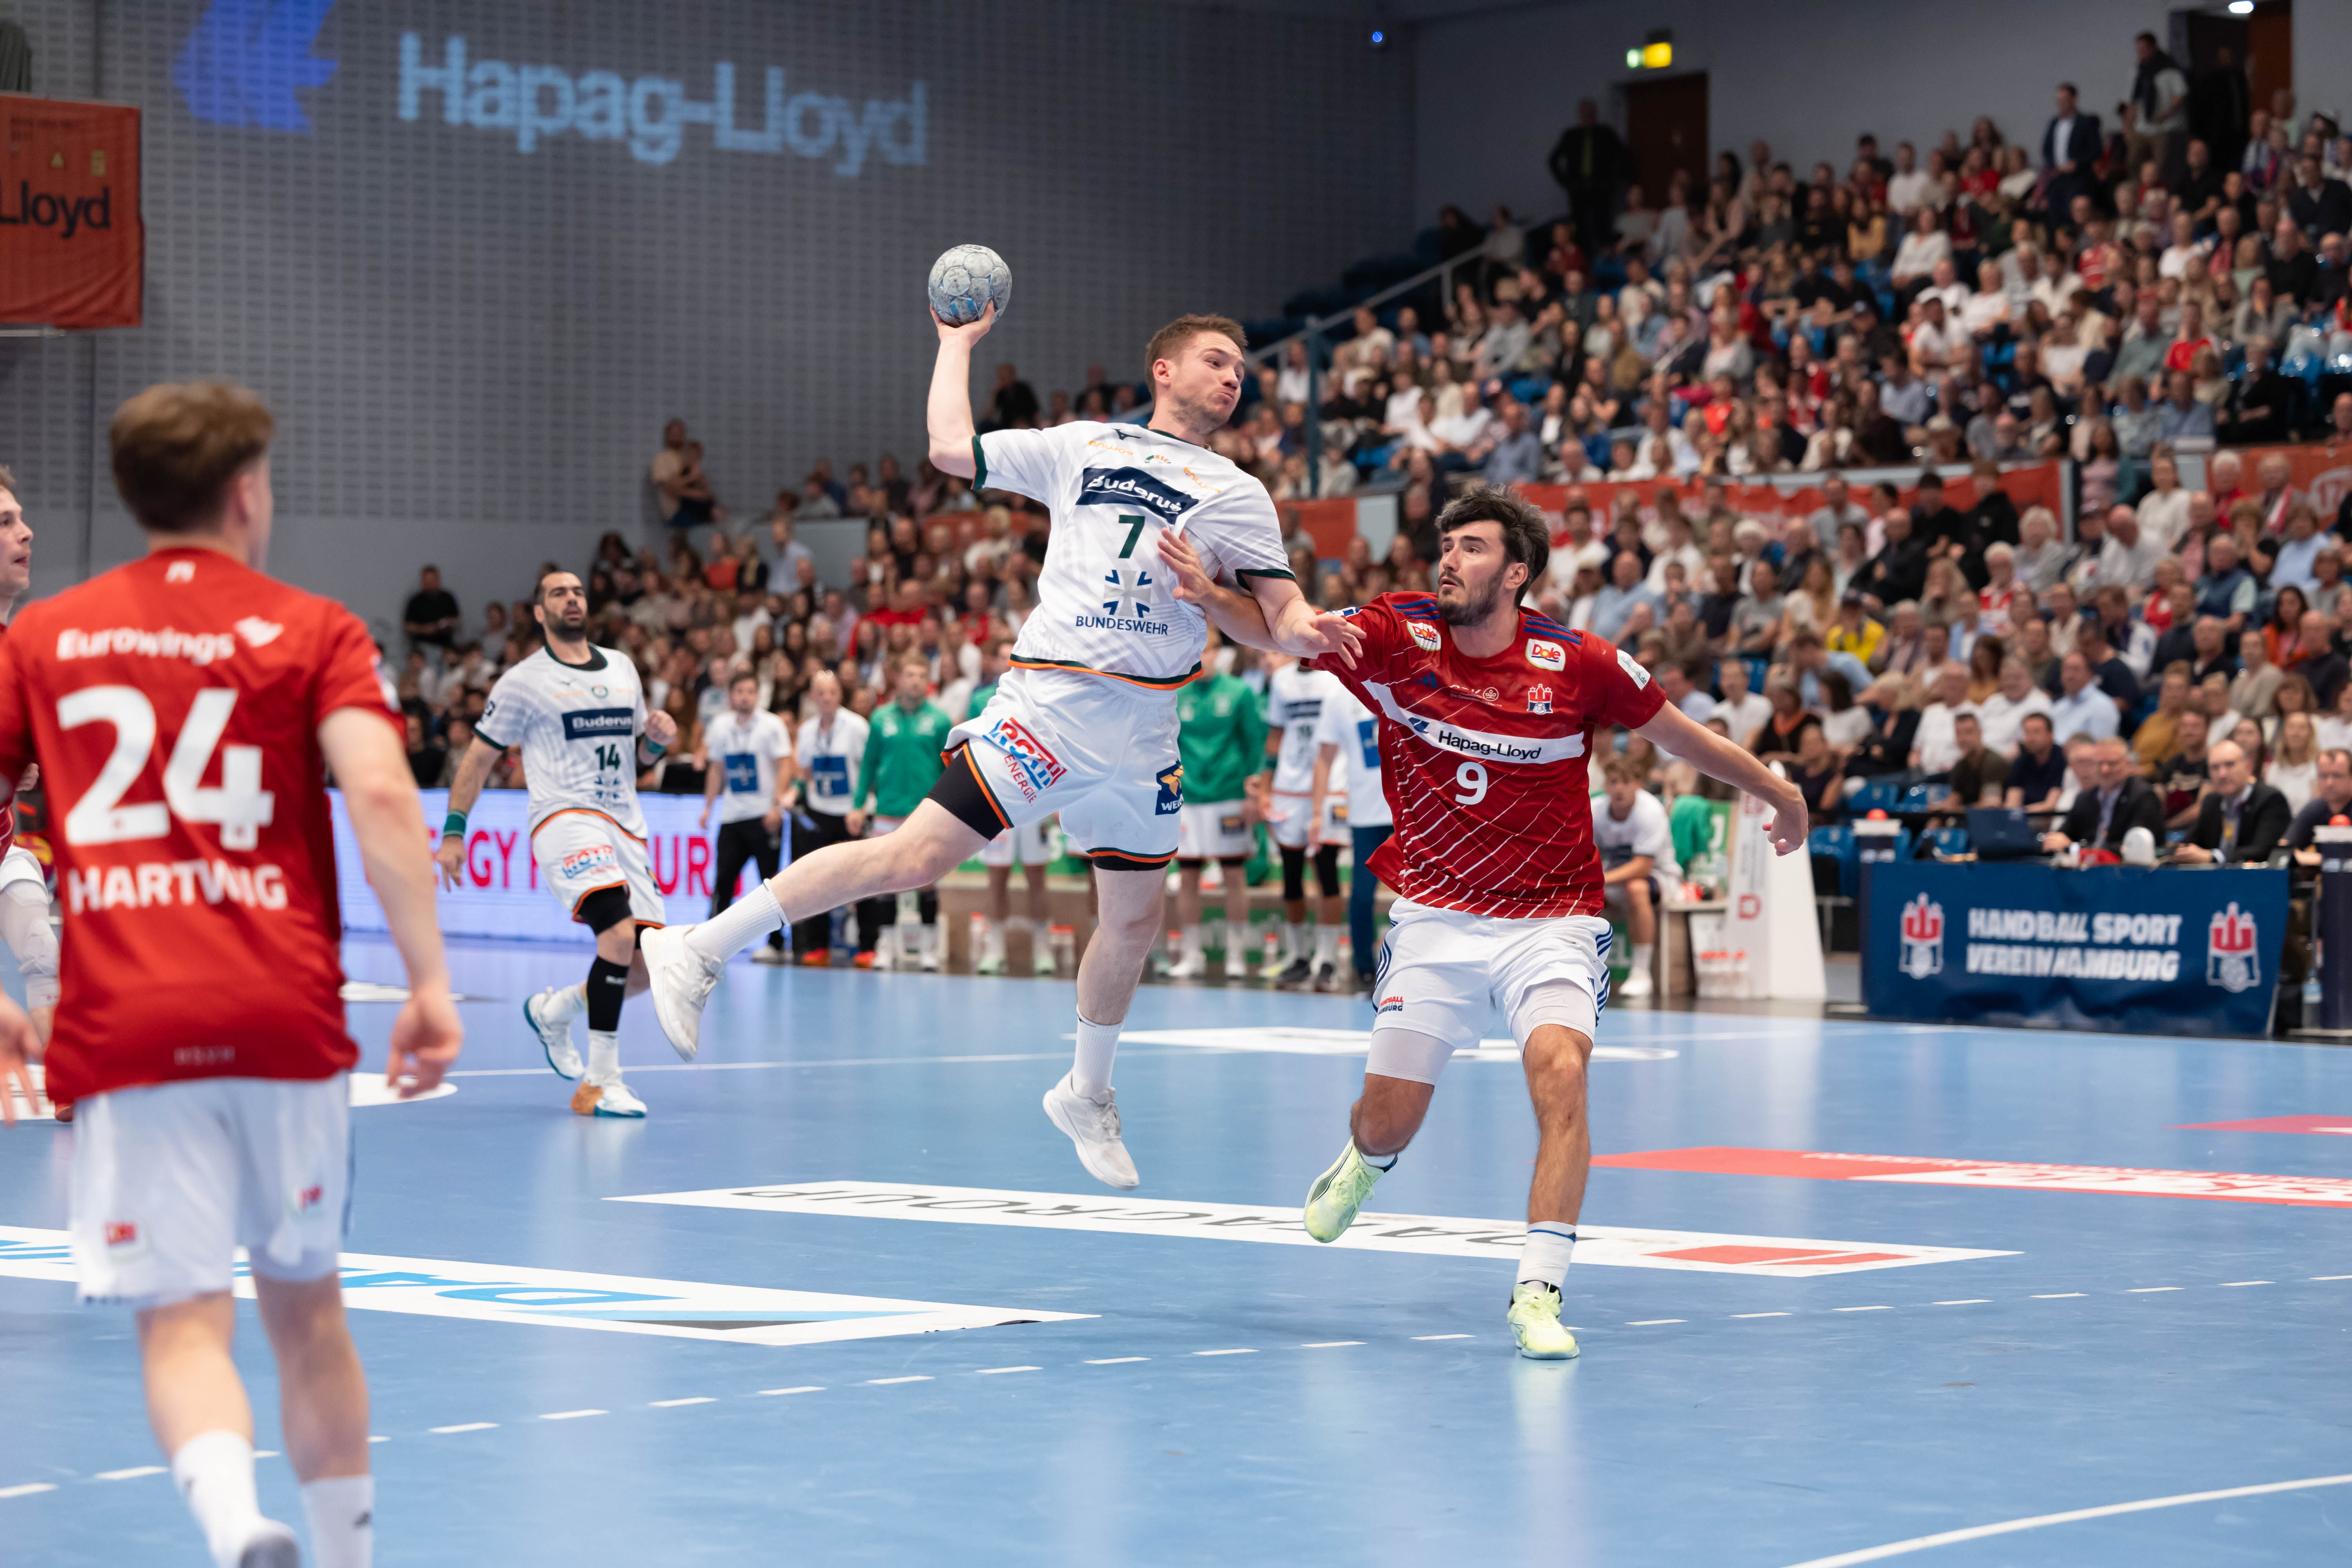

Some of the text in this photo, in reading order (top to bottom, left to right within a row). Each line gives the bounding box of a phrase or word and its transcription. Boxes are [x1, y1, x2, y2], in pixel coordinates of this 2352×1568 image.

[397, 31, 928, 176] Hapag-Lloyd
[1087, 475, 1182, 512] Buderus
[1118, 515, 1145, 559] 7
[1076, 615, 1169, 636] BUNDESWEHR
[1412, 626, 1437, 641] Dole
[56, 627, 235, 666] Eurowings
[1532, 644, 1561, 660] Dole
[595, 743, 621, 771] 14
[1438, 730, 1541, 760] Hapag-Lloyd
[56, 685, 275, 851] 24
[1455, 761, 1488, 805] 9
[68, 860, 289, 915] HARTWIG
[1968, 908, 2183, 945] HANDBALL SPORT
[1966, 943, 2180, 982] VEREIN HAMBURG
